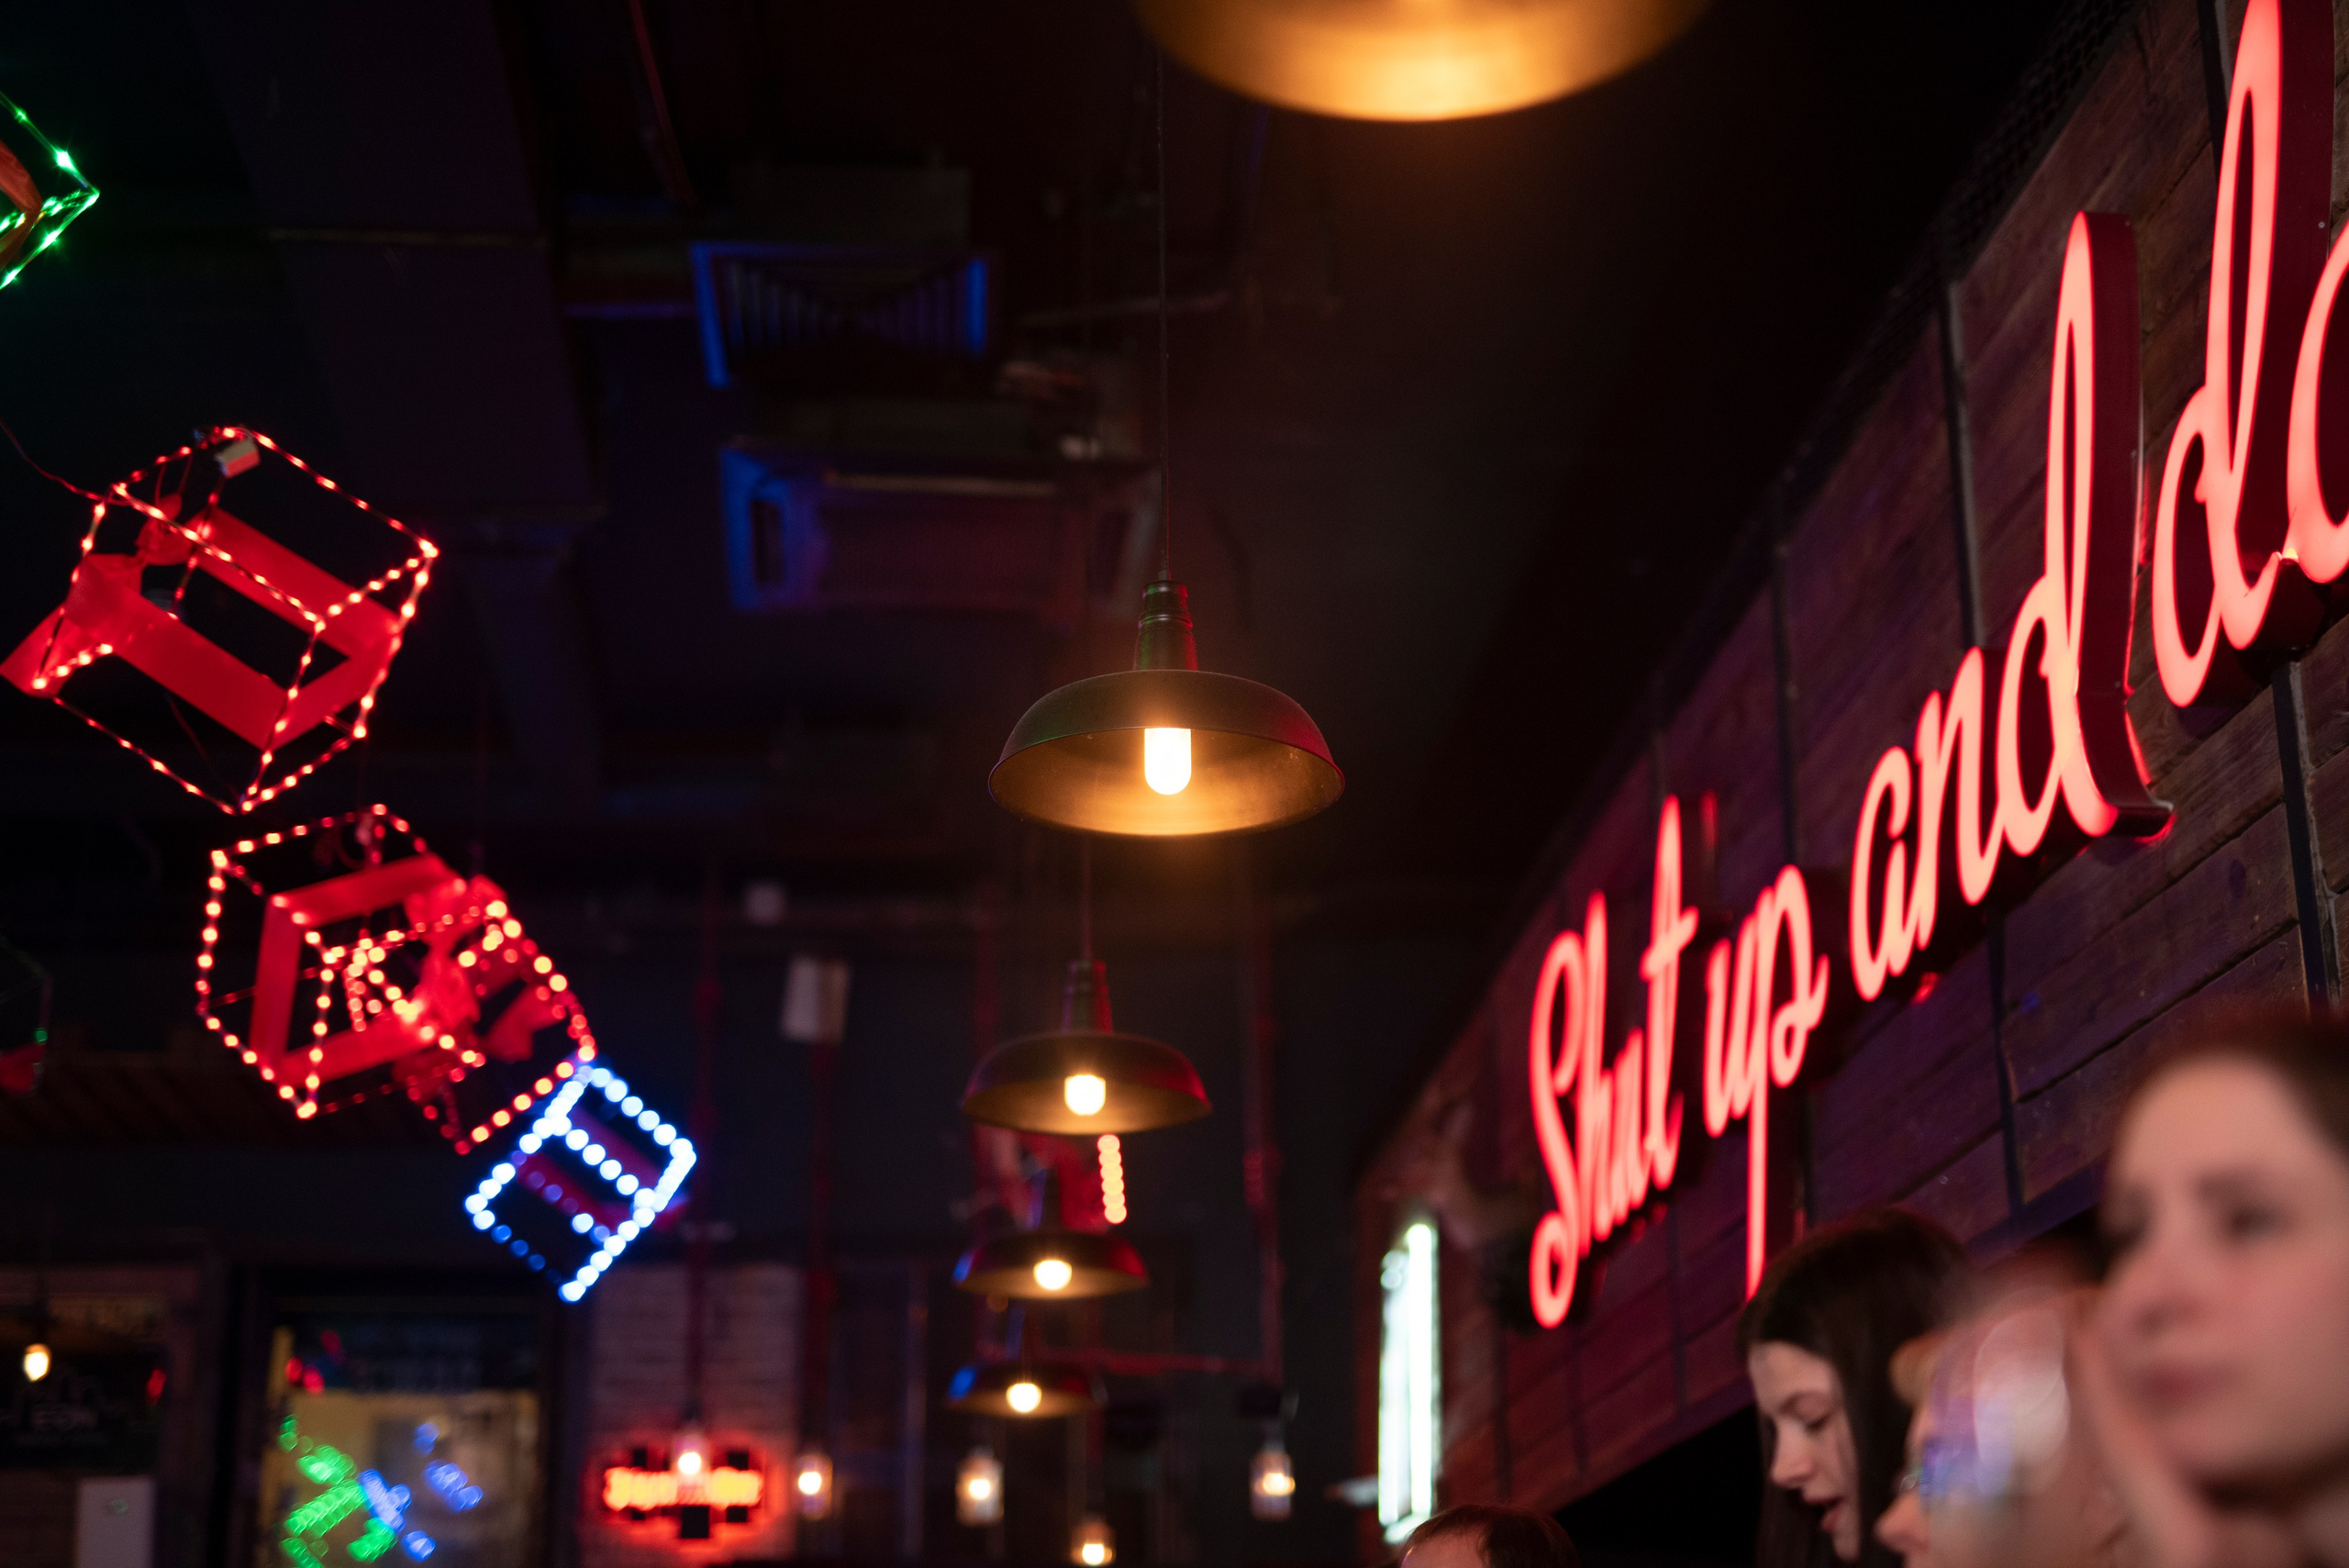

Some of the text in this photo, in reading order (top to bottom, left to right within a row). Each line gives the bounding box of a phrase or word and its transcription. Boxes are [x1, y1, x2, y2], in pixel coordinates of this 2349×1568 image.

[1529, 795, 1699, 1329] Shut
[1704, 864, 1829, 1303] up
[1849, 211, 2119, 1002] and
